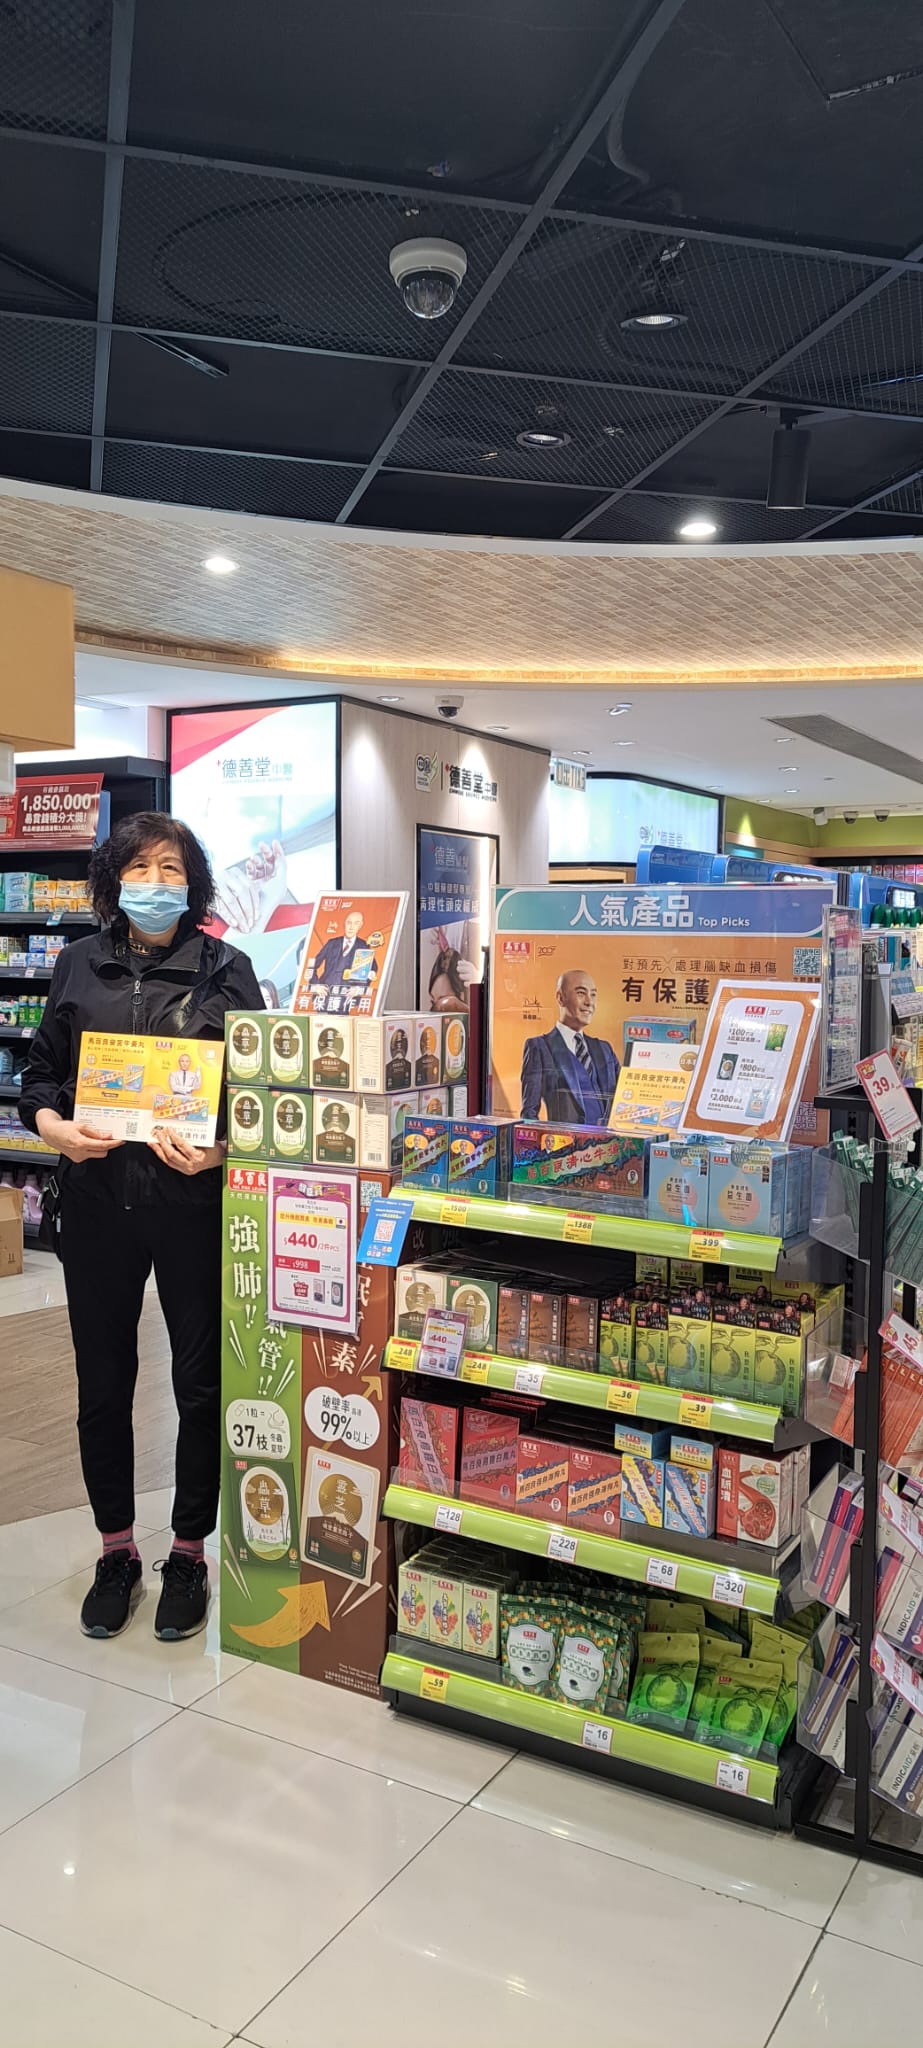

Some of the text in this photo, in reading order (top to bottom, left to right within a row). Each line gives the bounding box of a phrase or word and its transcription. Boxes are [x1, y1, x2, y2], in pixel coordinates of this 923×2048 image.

[21, 793, 92, 812] 1,850,000
[569, 894, 693, 929] 人氣產品
[698, 916, 750, 930] Top Picks
[623, 958, 663, 972] 對預先
[675, 959, 777, 975] 處理腦缺血損傷
[622, 976, 710, 1005] 有保護
[298, 995, 372, 1013] 有保護作用
[703, 1239, 719, 1248] 399
[472, 1361, 487, 1371] 248
[527, 1373, 539, 1384] 35
[621, 1391, 632, 1400] 36
[695, 1404, 706, 1414] 39
[320, 1410, 352, 1440] 99%
[445, 1511, 461, 1522] 128
[558, 1538, 577, 1551] 228
[660, 1565, 673, 1576] 68
[724, 1581, 744, 1594] 320
[896, 1599, 917, 1637] INDICAID
[433, 1678, 444, 1688] 59
[597, 1729, 609, 1741] 16
[731, 1770, 744, 1782] 16
[891, 1757, 912, 1793] INDICAID
